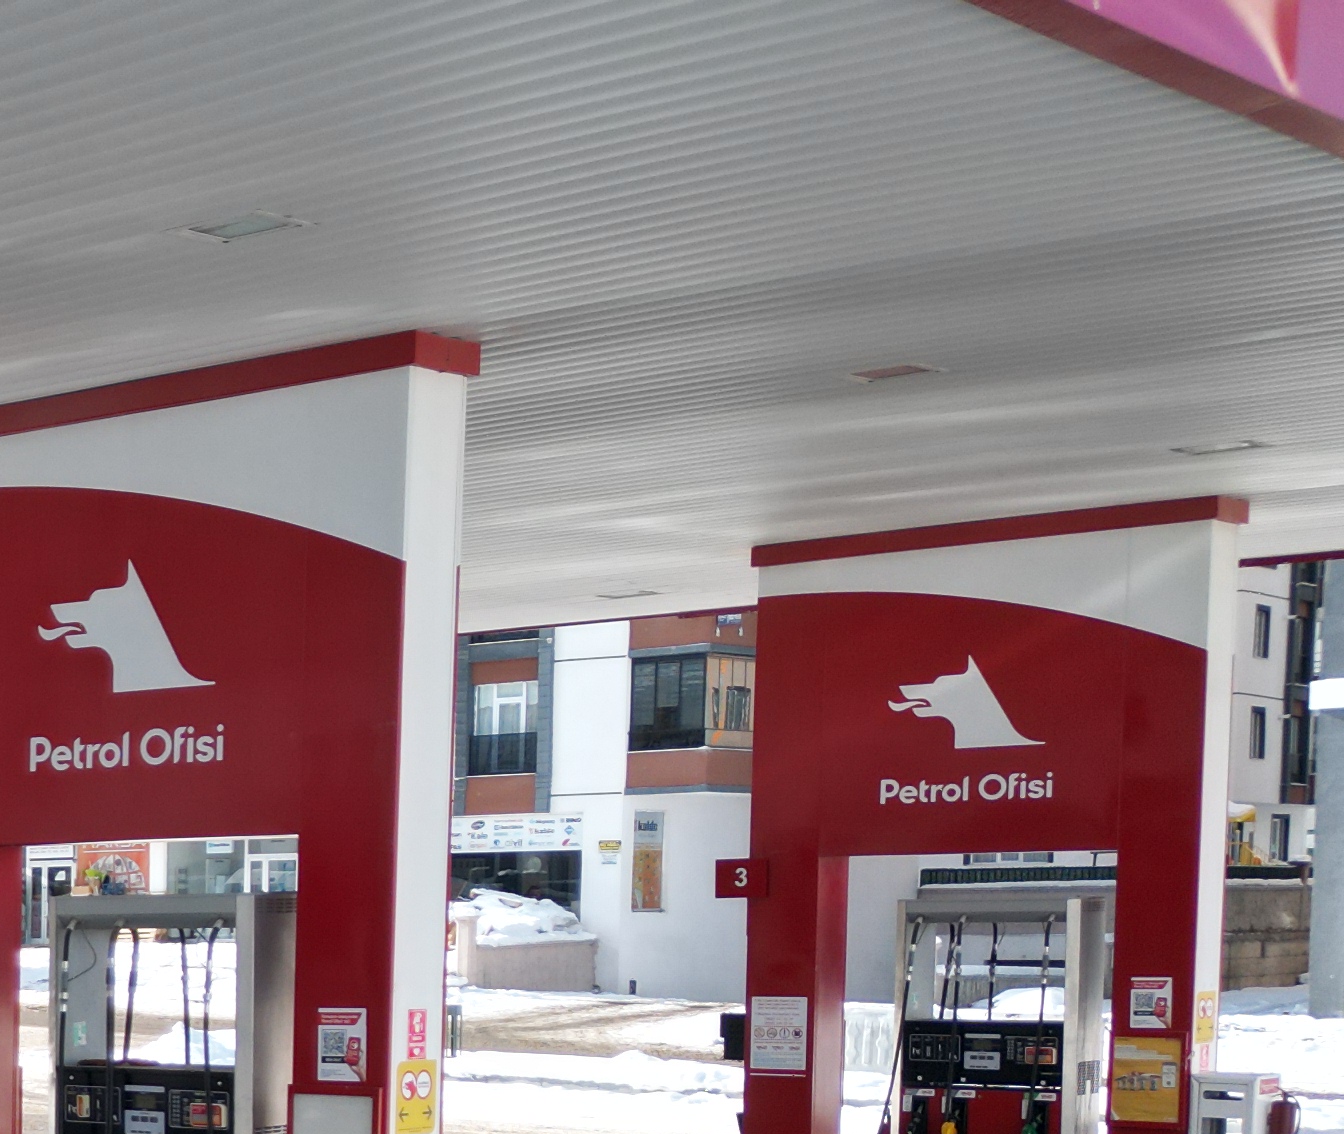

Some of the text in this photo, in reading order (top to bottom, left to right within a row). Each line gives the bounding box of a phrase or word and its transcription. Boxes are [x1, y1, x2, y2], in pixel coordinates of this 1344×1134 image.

[29, 723, 224, 772] Petrol Ofisi
[879, 771, 1053, 805] Petrol Ofisi
[734, 867, 748, 887] 3
